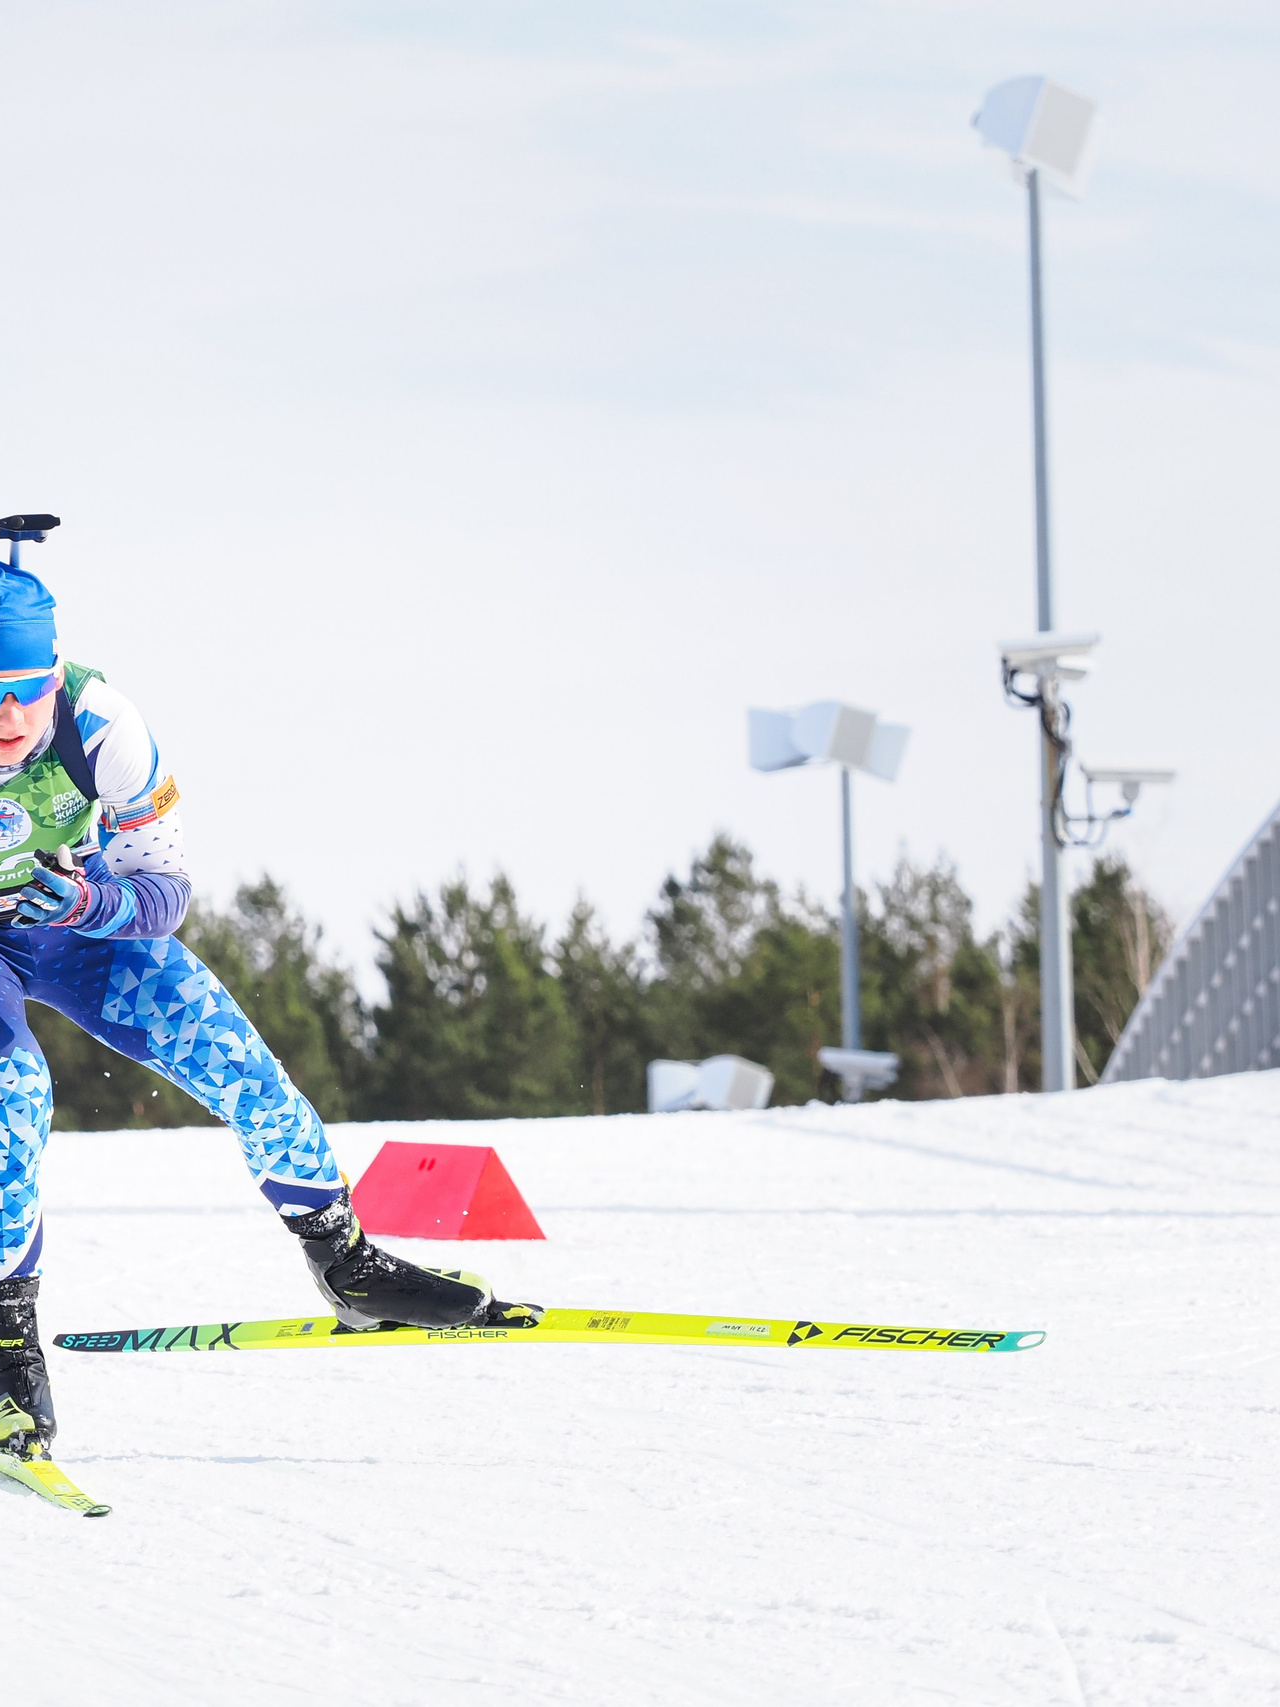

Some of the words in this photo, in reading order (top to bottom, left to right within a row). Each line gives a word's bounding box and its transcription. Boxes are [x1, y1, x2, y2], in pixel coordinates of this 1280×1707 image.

[62, 1335, 121, 1348] SPEED
[122, 1322, 243, 1352] MAX
[427, 1330, 508, 1340] FISCHER
[832, 1327, 1006, 1349] FISCHER
